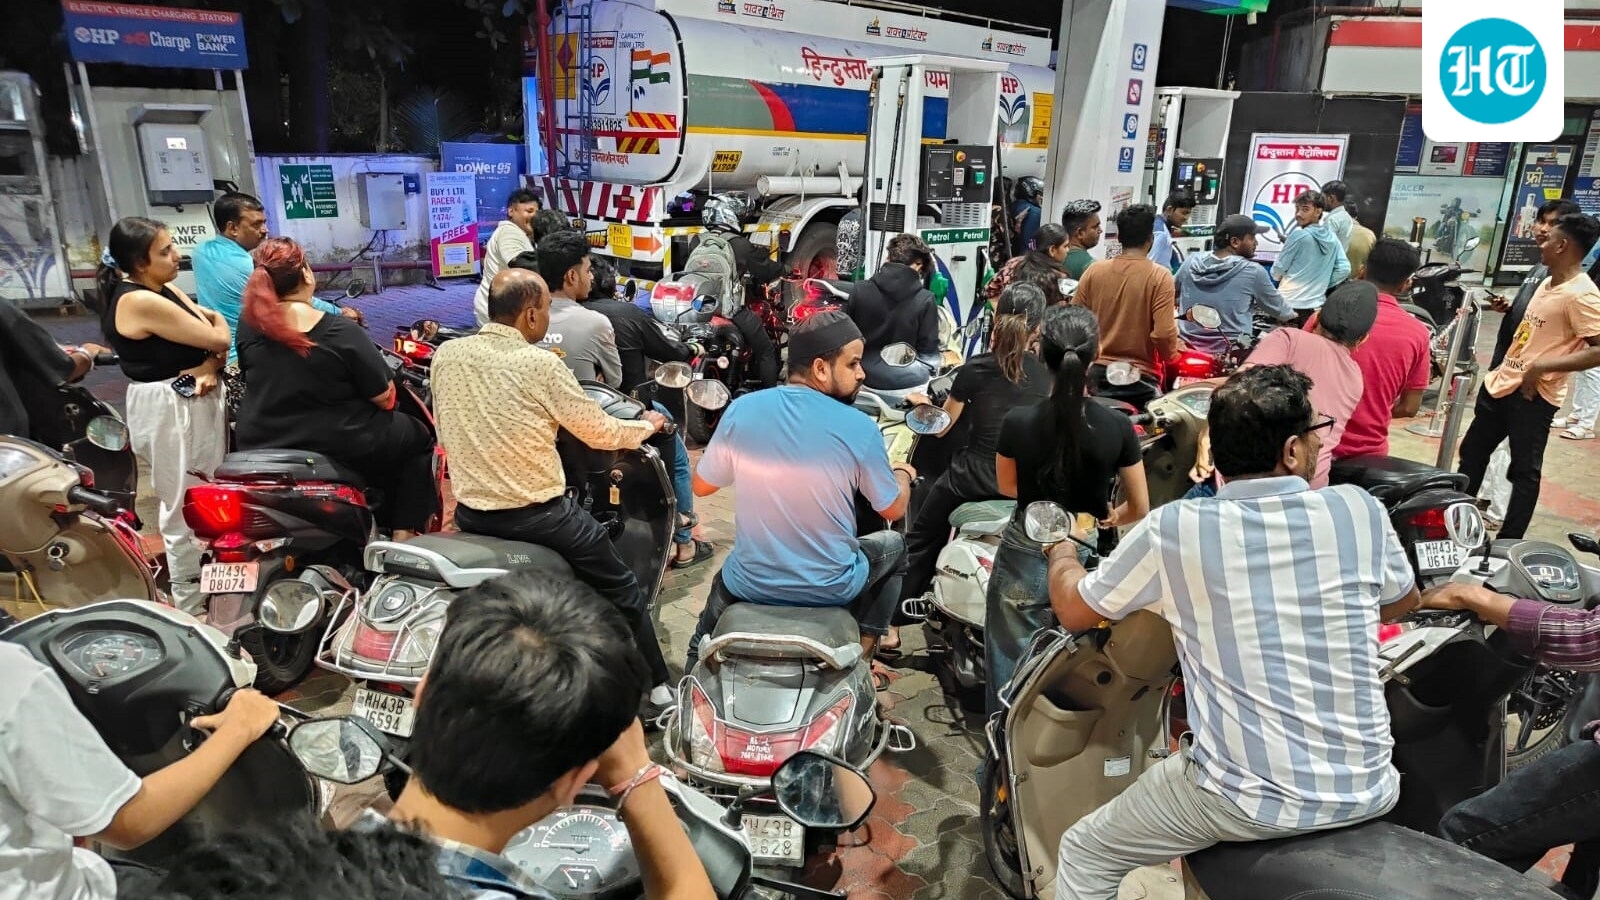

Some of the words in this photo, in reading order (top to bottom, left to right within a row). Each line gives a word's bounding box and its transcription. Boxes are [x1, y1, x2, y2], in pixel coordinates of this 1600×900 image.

[69, 4, 112, 14] ELECTRIC
[115, 7, 151, 17] VEHICLE
[151, 10, 197, 20] CHARGING
[199, 13, 233, 22] STATION
[89, 28, 119, 45] HP
[150, 31, 191, 51] Charge
[196, 33, 236, 44] POWER
[198, 42, 228, 52] BANK
[1001, 77, 1018, 94] HP
[715, 153, 740, 162] MH43
[497, 162, 512, 174] 95
[431, 188, 444, 196] BUY
[446, 188, 451, 196] 1
[453, 188, 465, 196] LTR
[1394, 184, 1425, 193] RACER
[431, 197, 455, 206] RACER
[168, 225, 207, 235] OWER
[442, 225, 465, 242] FREE
[171, 235, 198, 245] ANK
[927, 232, 950, 242] Petrol
[963, 231, 984, 240] Petrol
[1427, 554, 1459, 568] U6146
[211, 565, 248, 578] MH43C
[209, 579, 246, 592] D8074
[364, 691, 405, 715] MH43B
